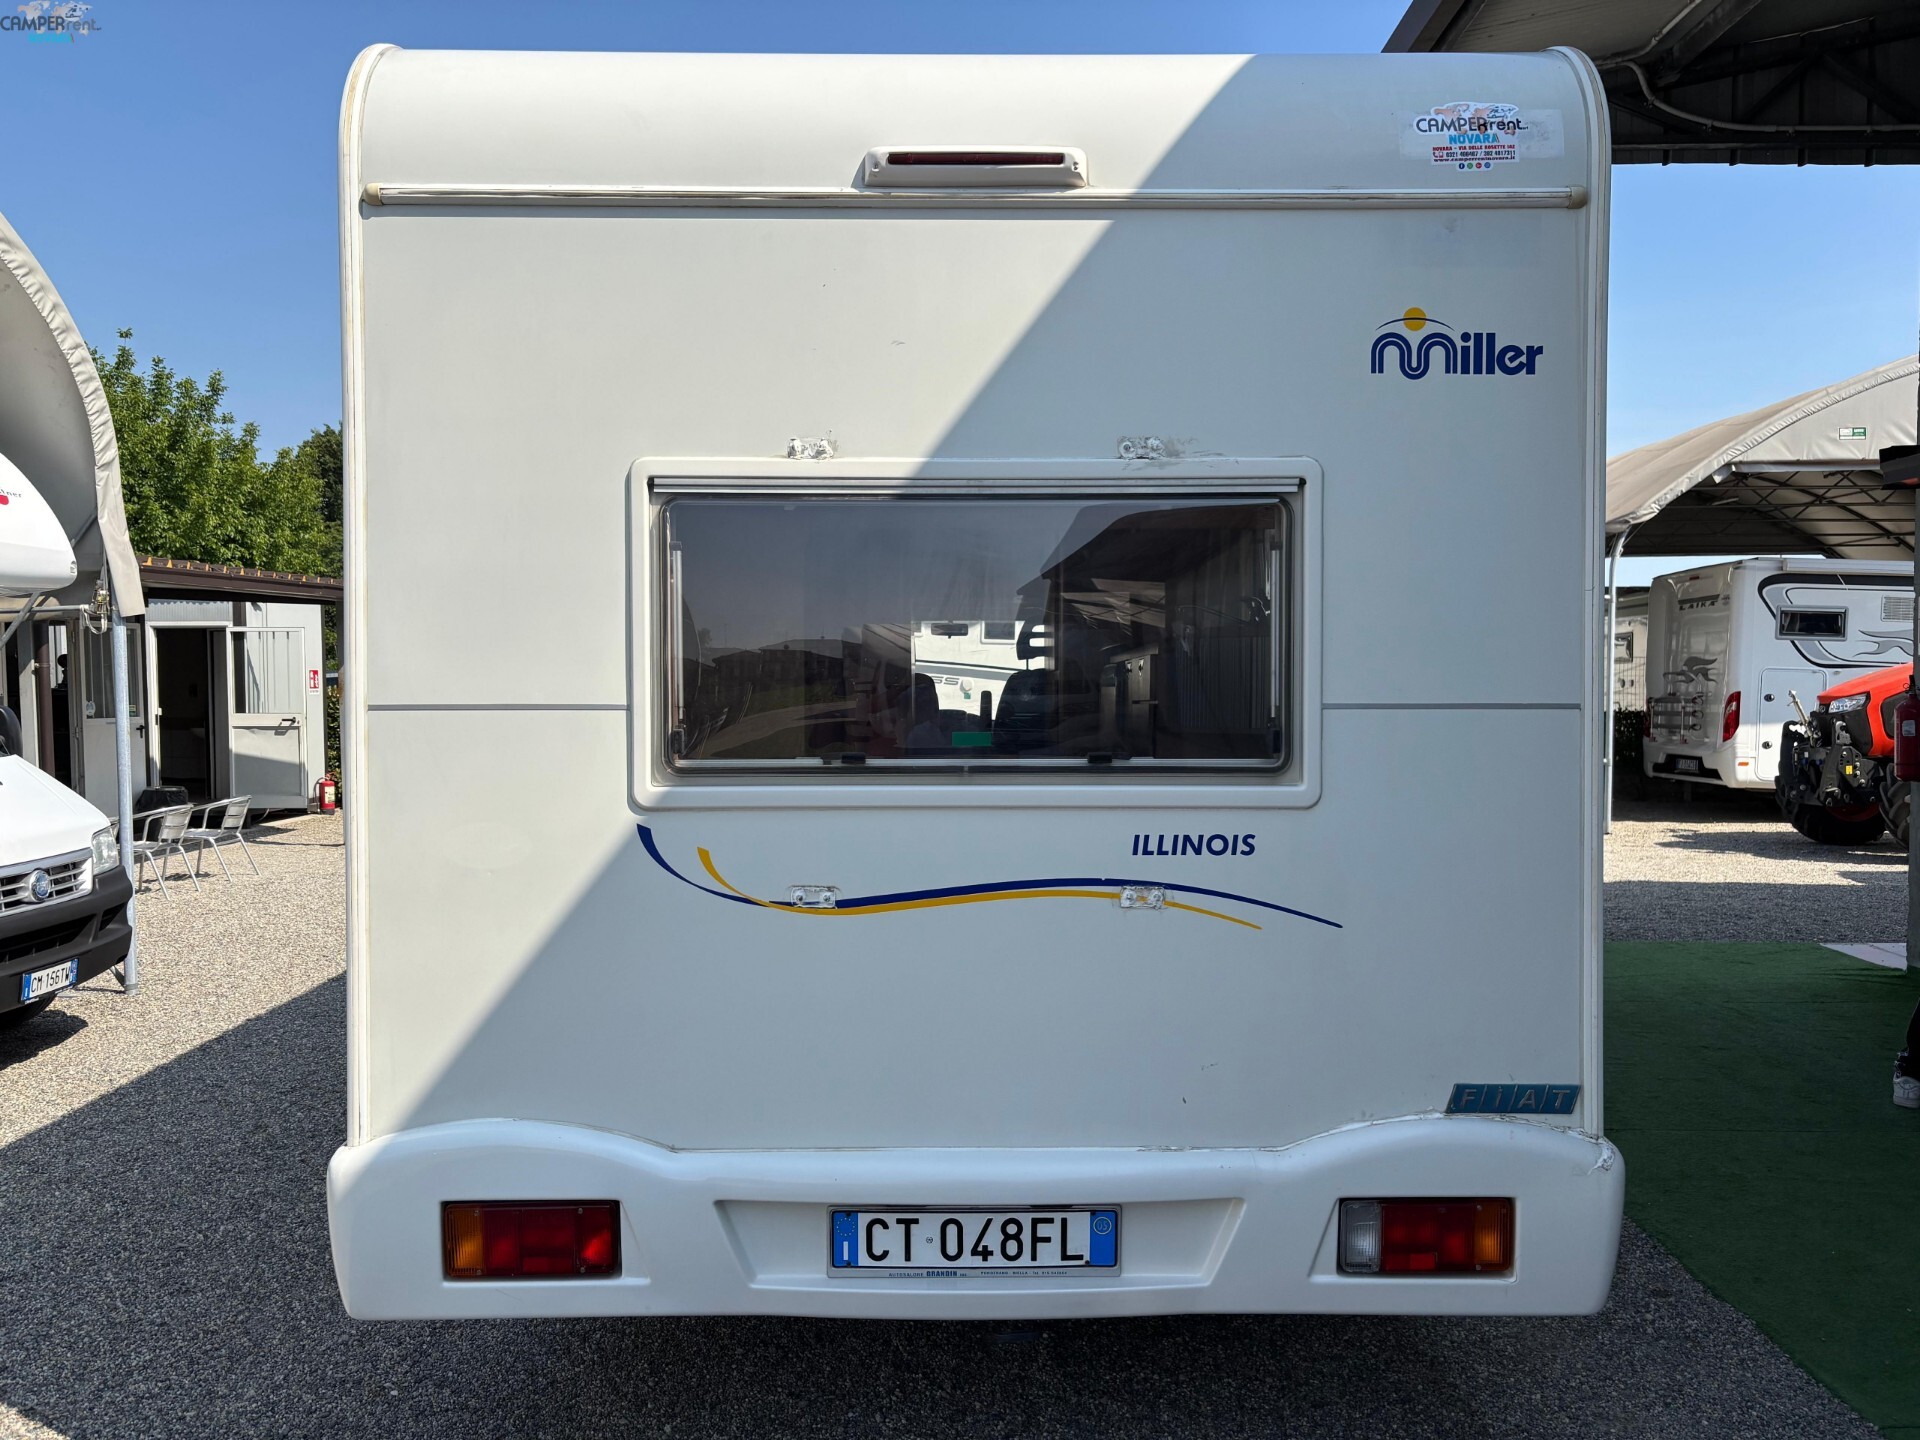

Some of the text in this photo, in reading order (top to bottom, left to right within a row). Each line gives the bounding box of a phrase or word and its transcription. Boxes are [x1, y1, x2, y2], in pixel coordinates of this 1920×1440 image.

[1449, 132, 1500, 144] NOVARA
[1370, 331, 1544, 380] Miller
[1679, 600, 1717, 611] LAIKA
[1132, 833, 1256, 856] ILLINOIS
[31, 974, 43, 993] CM
[1460, 1086, 1571, 1110] FIAT
[865, 1217, 920, 1262] CT
[940, 1217, 1084, 1262] 048FL
